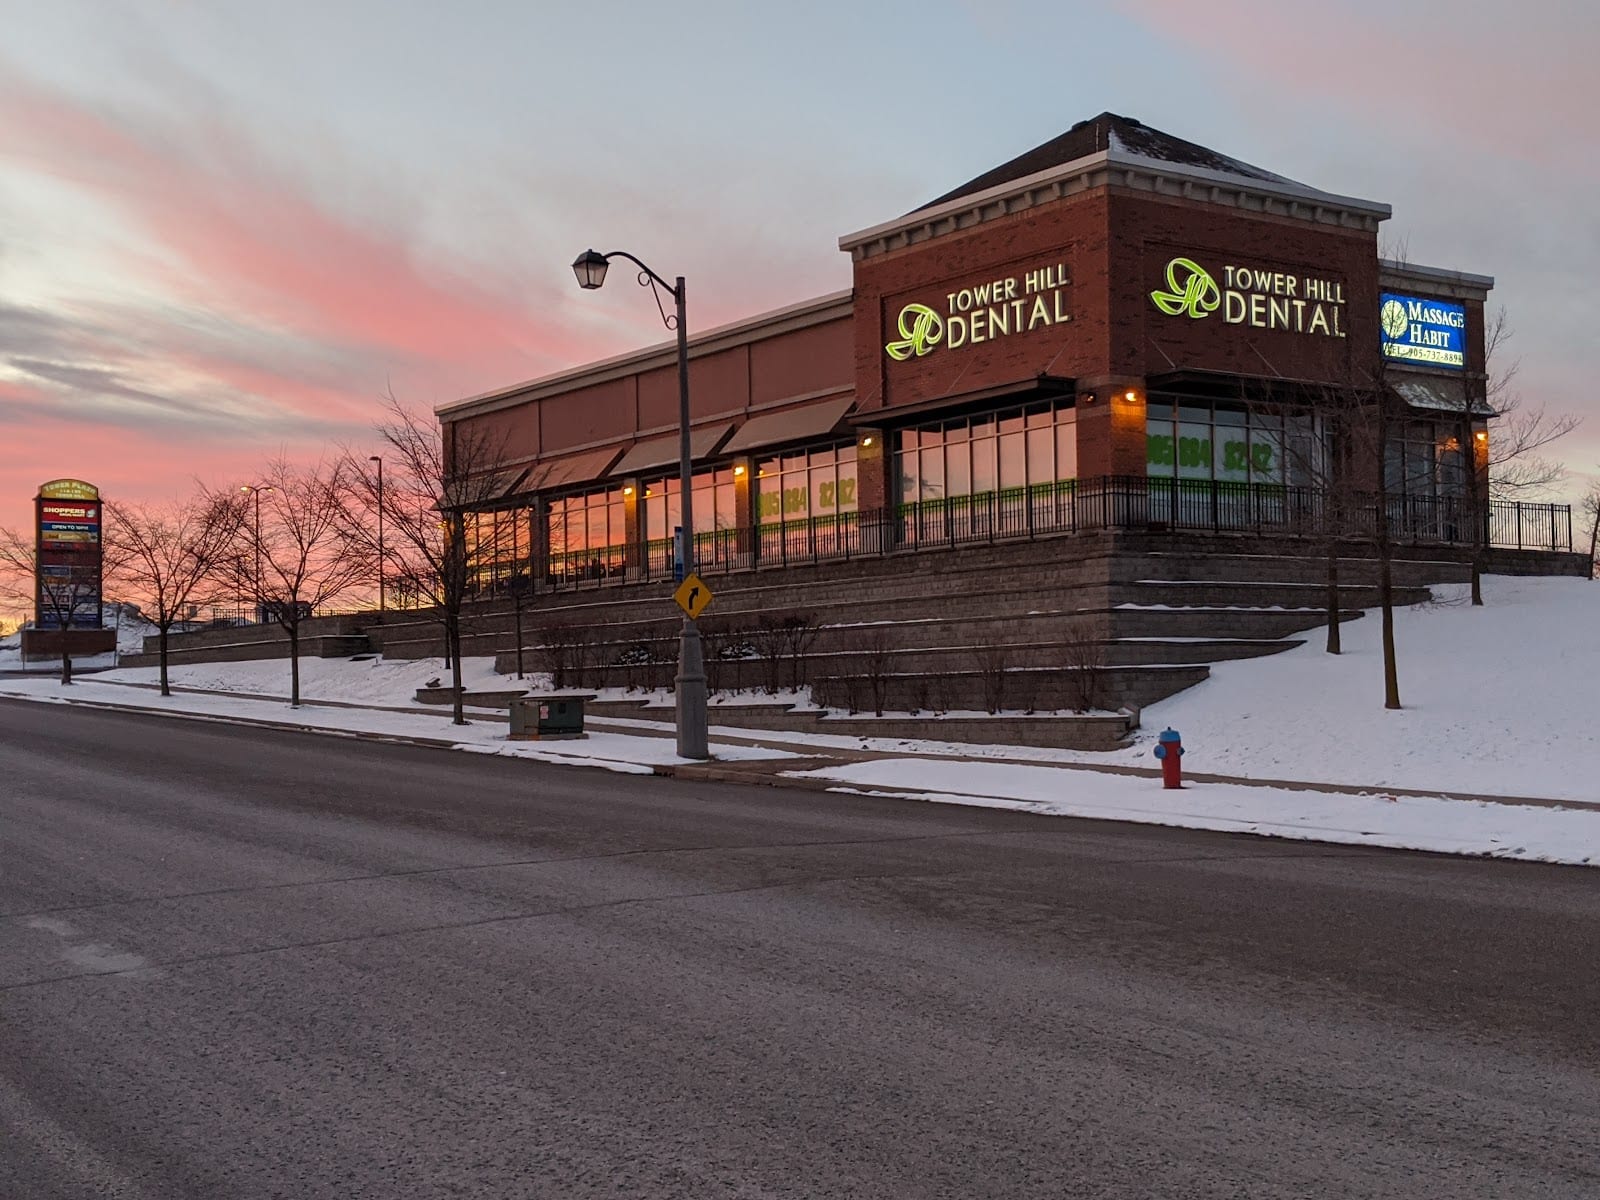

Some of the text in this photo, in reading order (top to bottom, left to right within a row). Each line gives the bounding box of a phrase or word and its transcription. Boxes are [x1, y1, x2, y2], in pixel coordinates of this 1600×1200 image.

[947, 263, 1069, 314] TOWER HILL
[1223, 265, 1346, 304] TOWER HILL
[947, 290, 1071, 350] DENTAL
[1225, 291, 1346, 338] DENTAL
[1408, 302, 1464, 328] MASSAGE
[1410, 324, 1449, 347] HABIT
